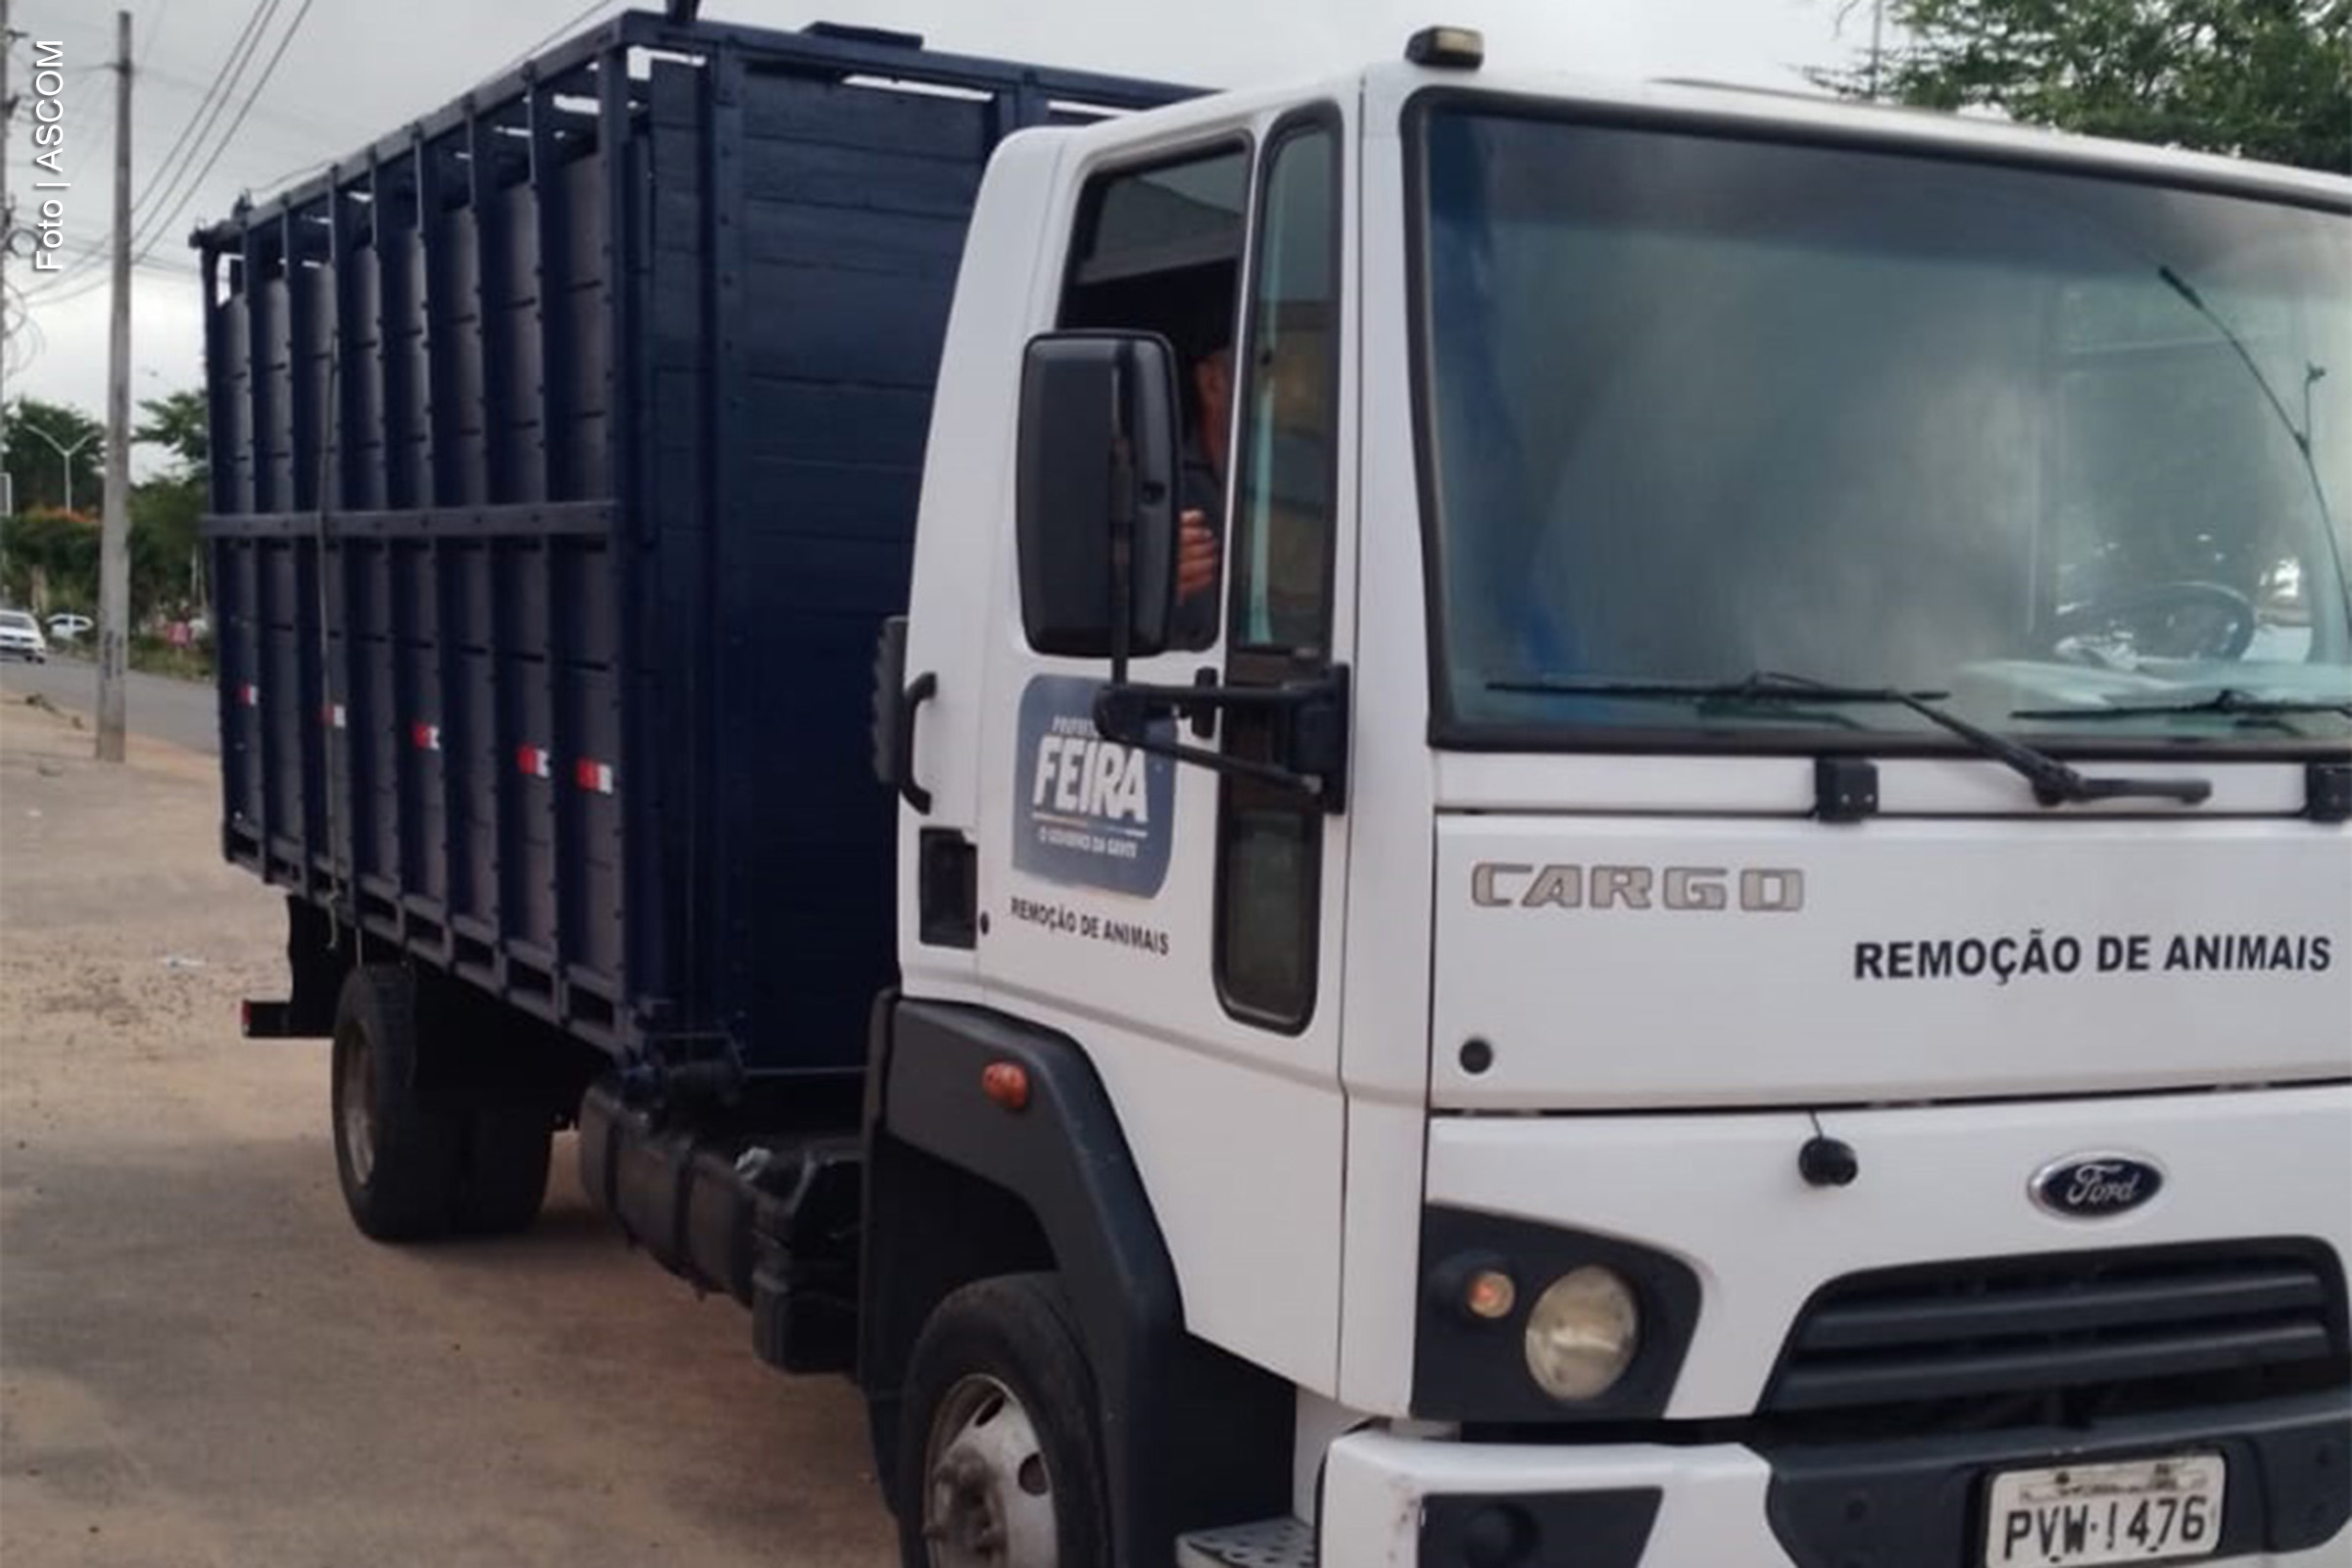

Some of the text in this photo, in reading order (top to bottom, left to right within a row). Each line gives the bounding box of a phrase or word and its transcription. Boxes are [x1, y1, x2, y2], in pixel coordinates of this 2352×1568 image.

[1032, 735, 1150, 823] FEIRA
[1471, 862, 1804, 911] CARGO
[1010, 897, 1170, 956] REMOÇÃO DE ANIMAIS
[1854, 928, 2332, 986] REMOÇÃO DE ANIMAIS
[2066, 1163, 2141, 1205] Ford
